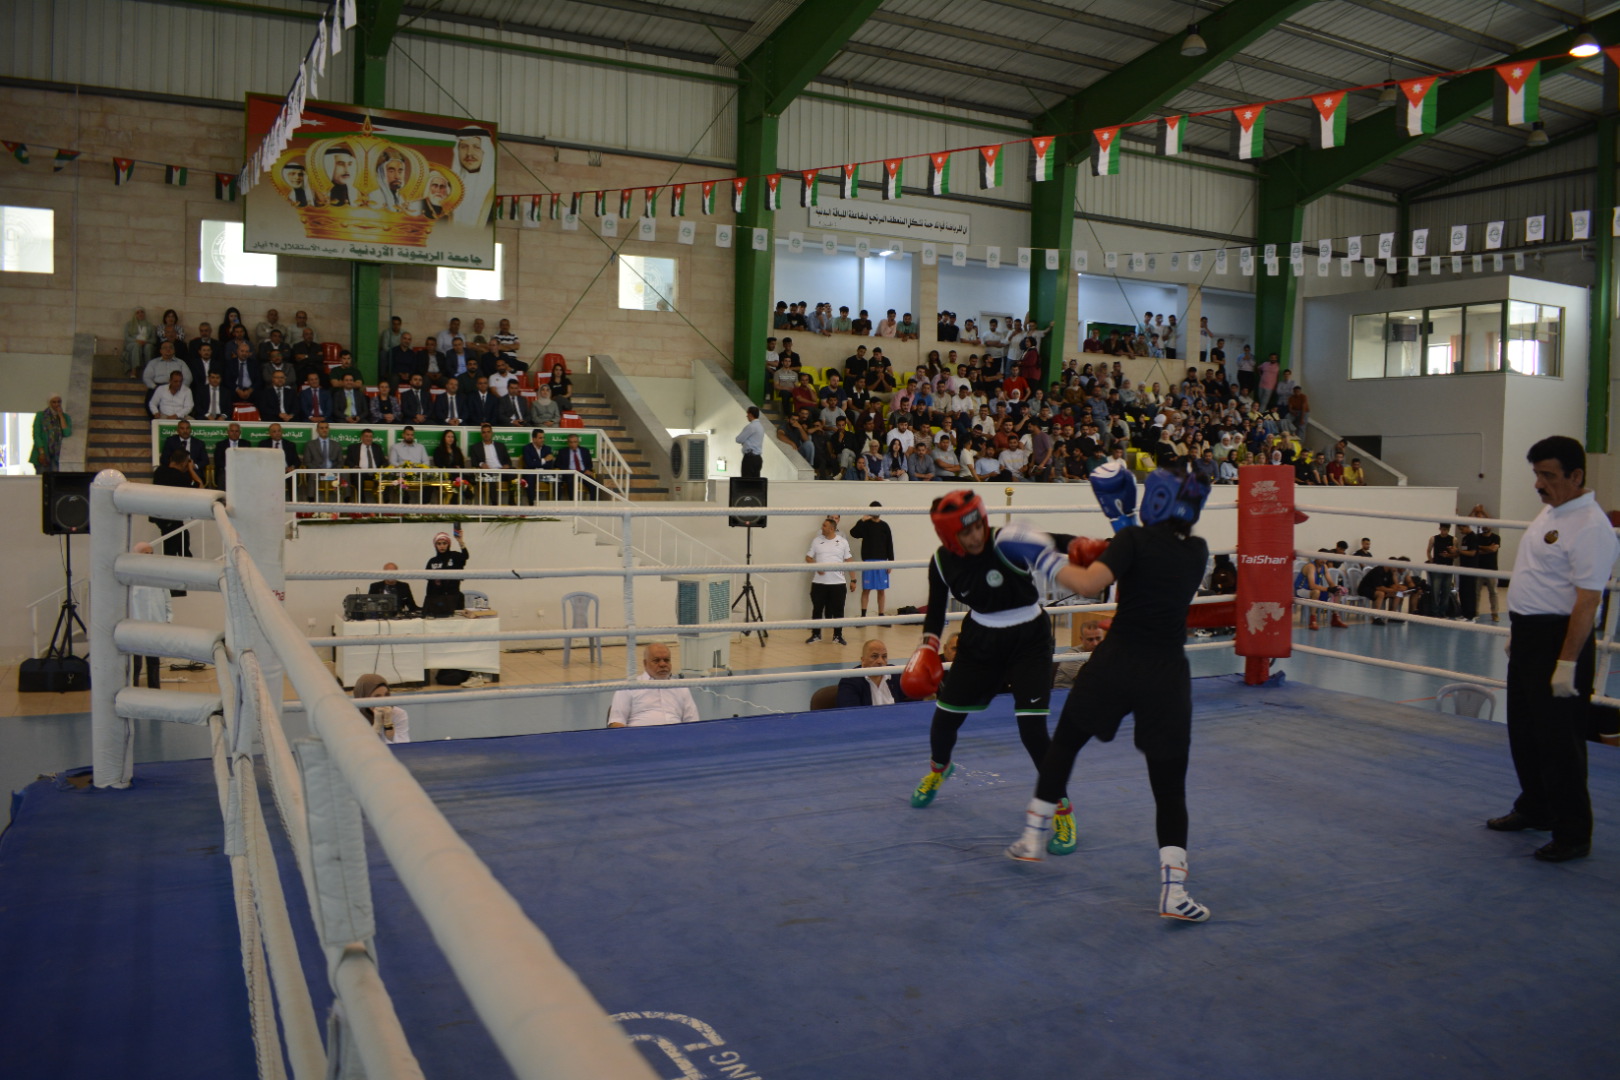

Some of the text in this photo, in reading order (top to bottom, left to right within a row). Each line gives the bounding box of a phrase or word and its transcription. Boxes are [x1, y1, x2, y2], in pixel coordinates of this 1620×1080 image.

[322, 246, 338, 255] عيد
[396, 247, 444, 262] الزيتونة
[447, 251, 483, 264] جامعة
[1240, 554, 1287, 565] TaiShan
